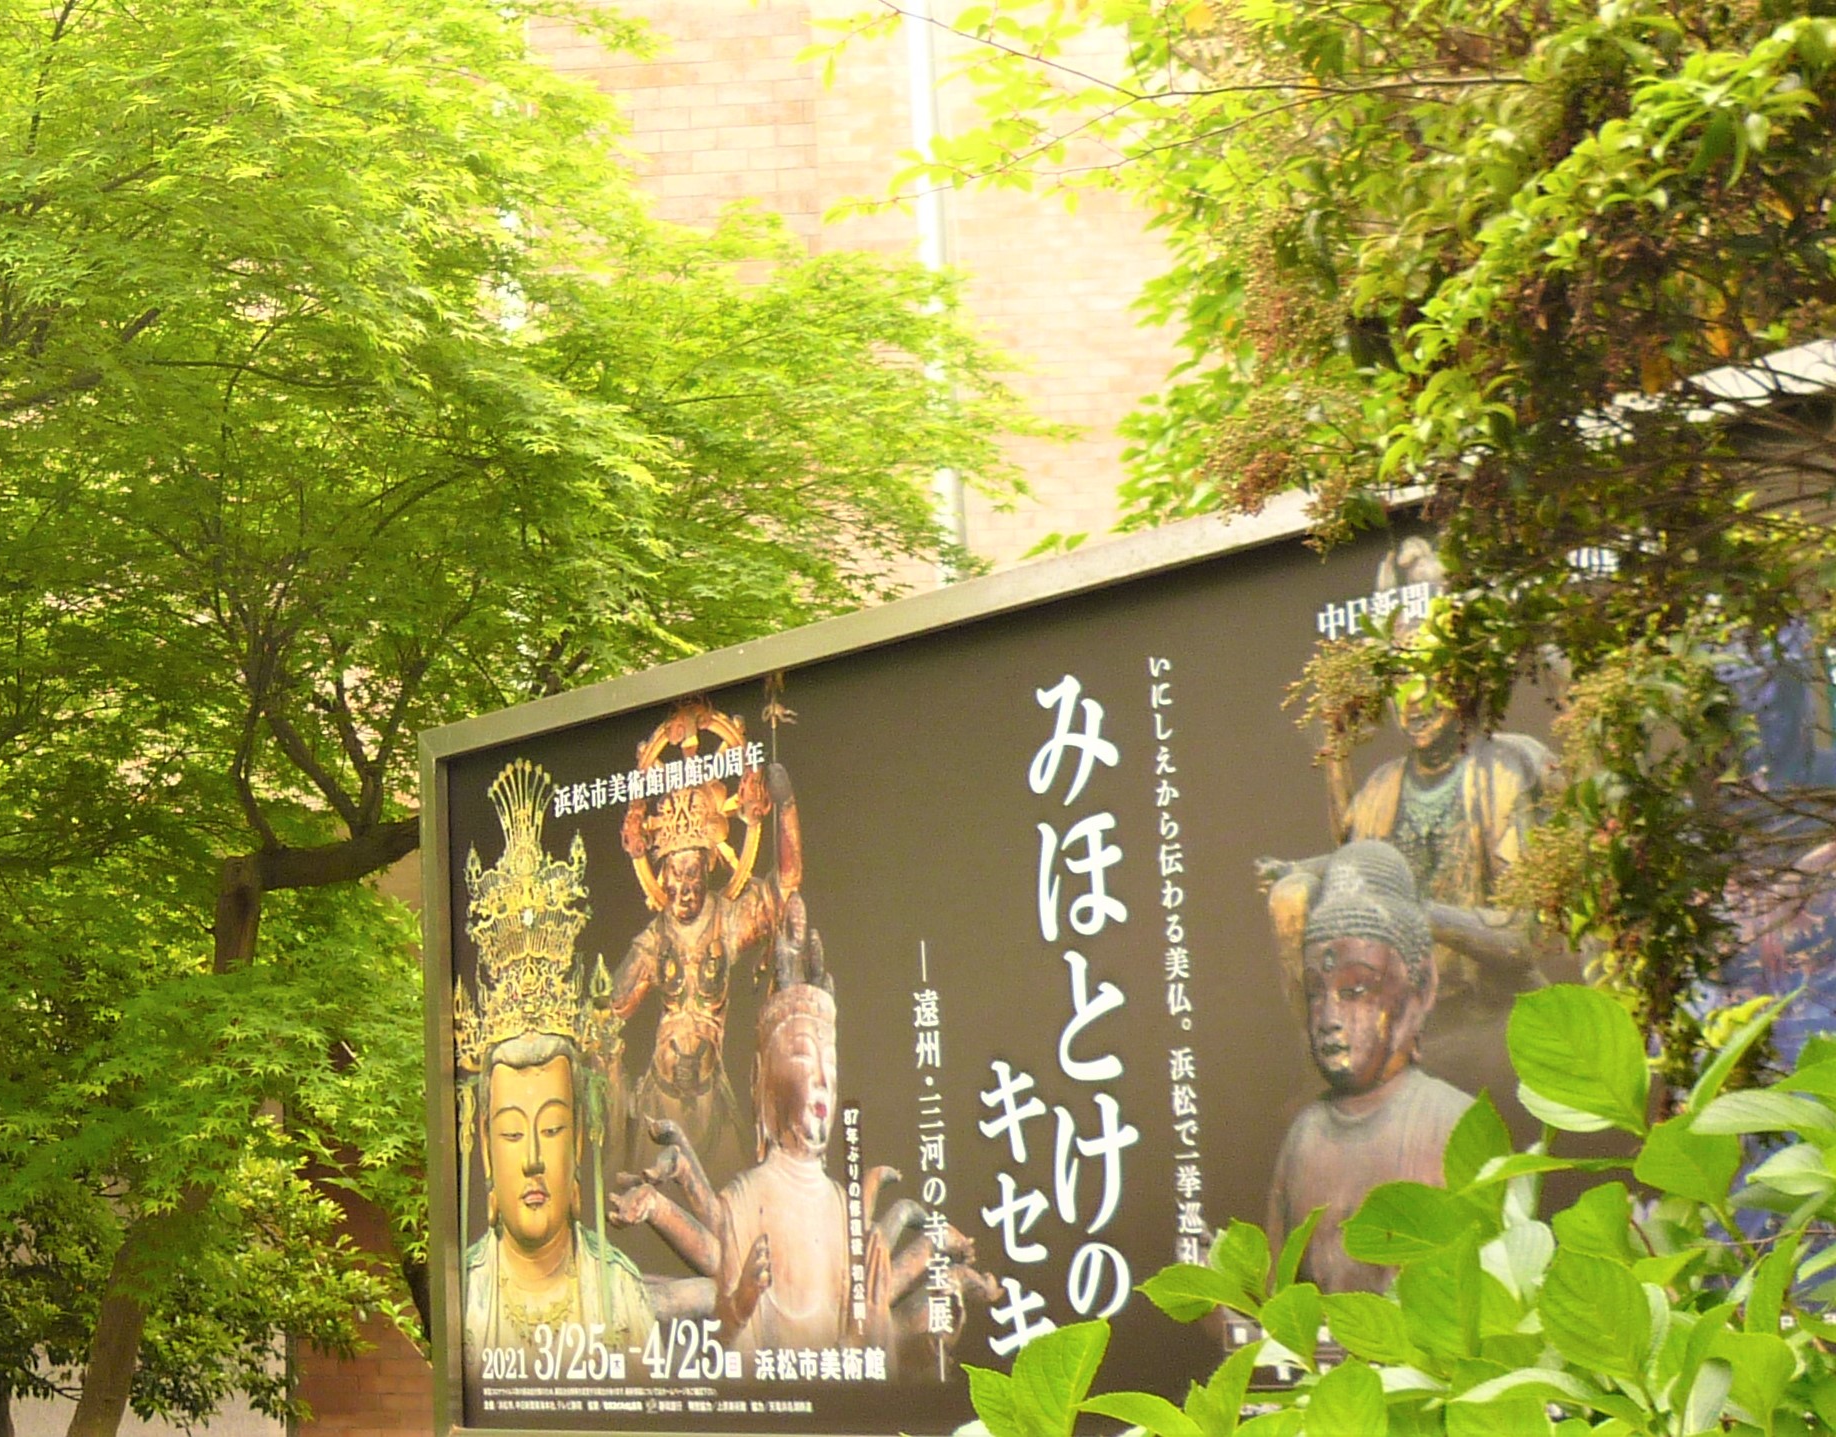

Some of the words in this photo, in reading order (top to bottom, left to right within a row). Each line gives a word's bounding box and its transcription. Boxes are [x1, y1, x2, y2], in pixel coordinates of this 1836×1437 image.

[553, 741, 765, 818] 浜松市美術館開館50周年
[1028, 674, 1140, 1319] みほとけの
[978, 1061, 1057, 1357] キセキ
[482, 1347, 529, 1380] 2021
[754, 1347, 887, 1381] 浜松市美術館
